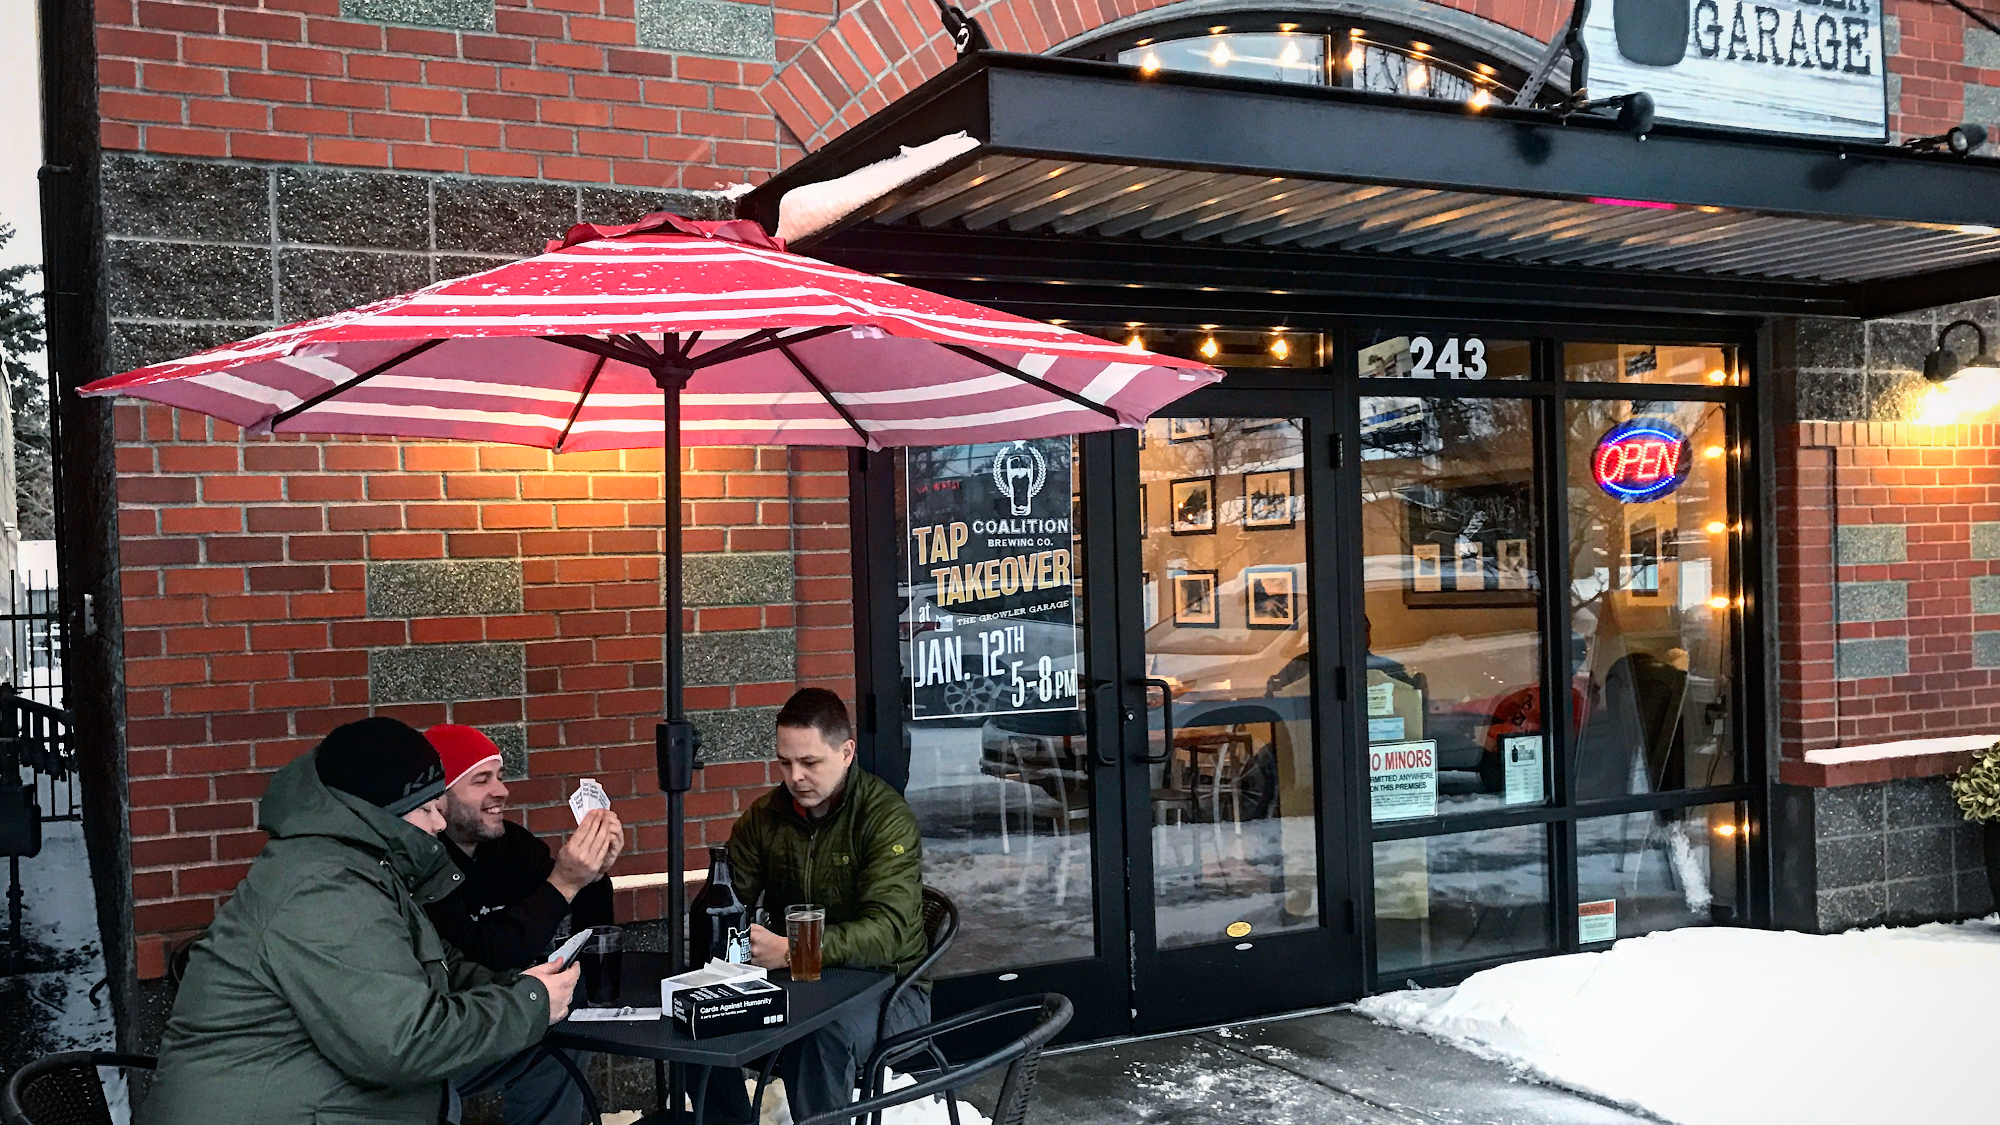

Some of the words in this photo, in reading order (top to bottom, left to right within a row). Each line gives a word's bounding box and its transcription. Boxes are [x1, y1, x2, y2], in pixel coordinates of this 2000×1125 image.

[1693, 0, 1871, 75] GARAGE
[1409, 336, 1488, 380] 243
[1600, 440, 1682, 481] OPEN
[972, 518, 1069, 535] COALITION
[912, 521, 969, 566] TAP
[987, 538, 1034, 547] BREWING
[1036, 538, 1054, 547] CO.
[931, 549, 1071, 607] TAKEOVER
[918, 602, 931, 623] at
[957, 615, 977, 626] THE
[979, 607, 1027, 622] GROWLER
[1028, 600, 1070, 614] GARAGE
[914, 635, 971, 688] JAN.
[979, 625, 1025, 678] 12TH
[1369, 753, 1381, 771] O
[1385, 748, 1432, 770] MINORS
[1370, 775, 1397, 783] RMITTED
[1399, 772, 1434, 781] ANYWHERE
[1395, 782, 1427, 791] PREMISES
[700, 1005, 719, 1014] Cards
[720, 1001, 743, 1012] Against
[743, 998, 773, 1007] Humanity
